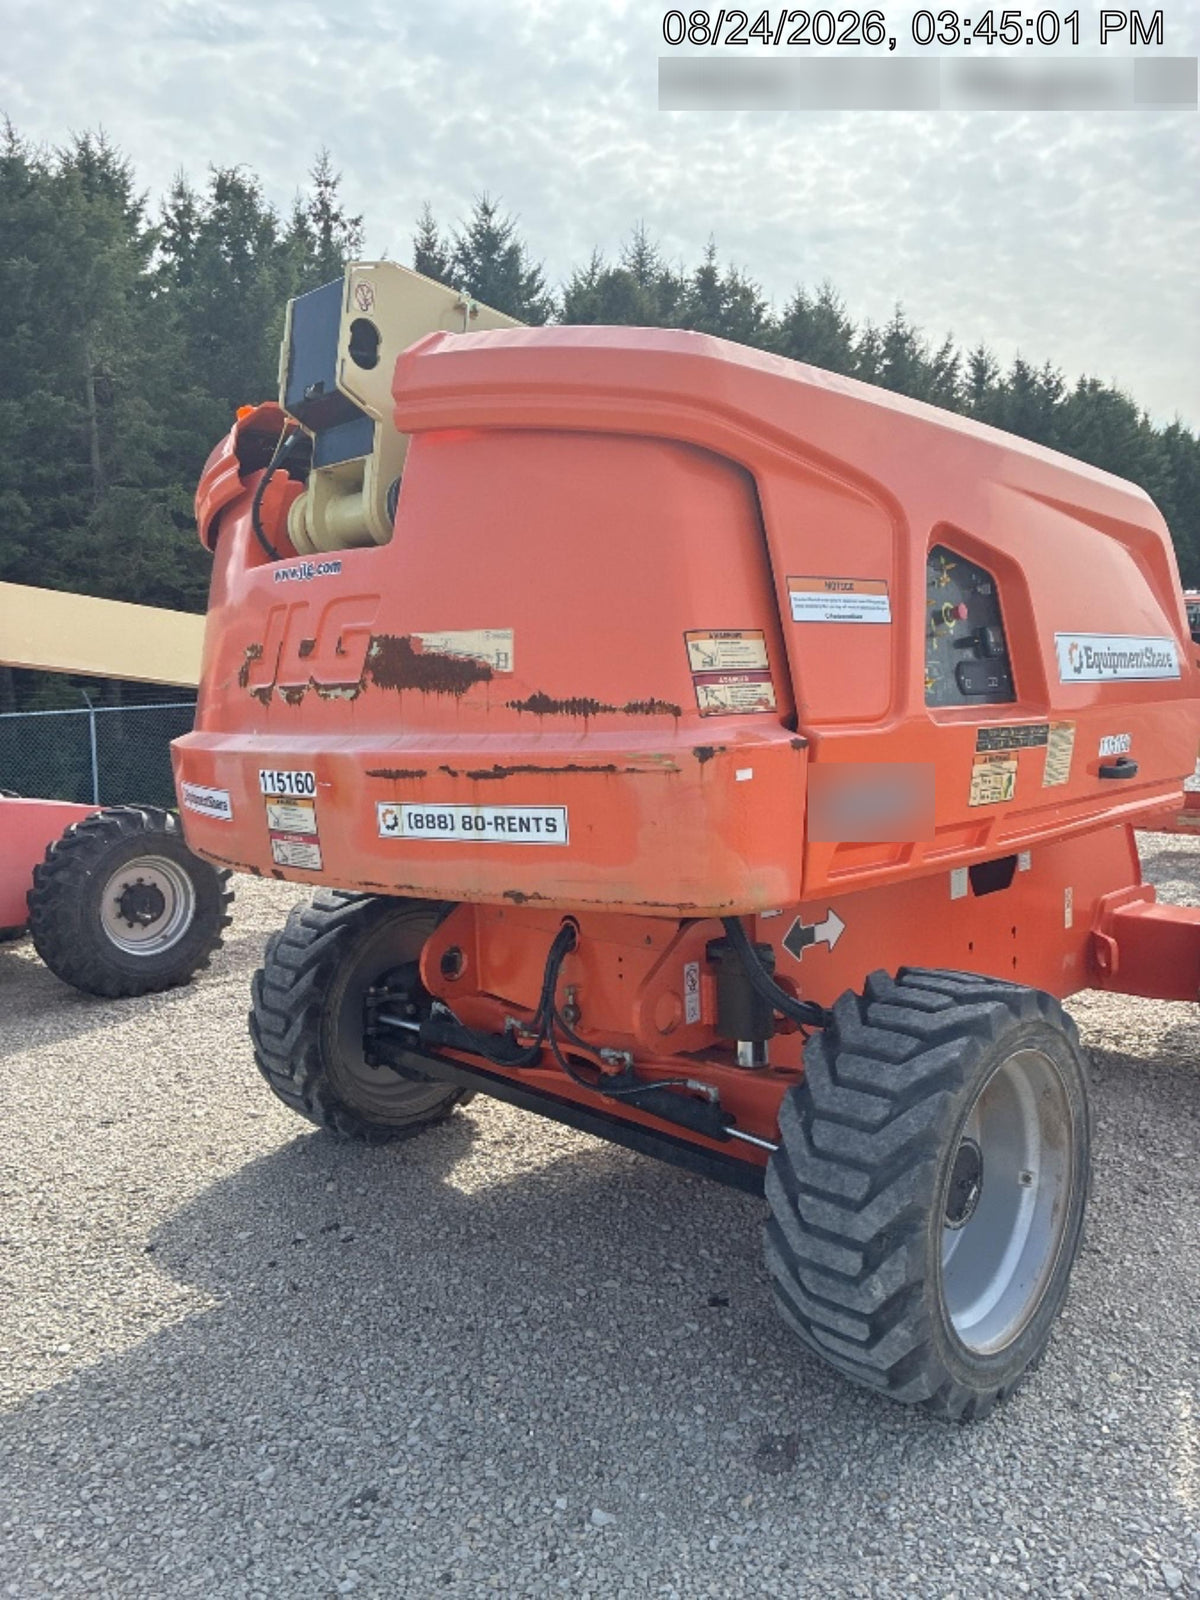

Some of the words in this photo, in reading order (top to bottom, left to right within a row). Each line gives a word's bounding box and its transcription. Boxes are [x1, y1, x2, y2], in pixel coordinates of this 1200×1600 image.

[274, 561, 342, 581] www.jlg.com
[247, 593, 381, 687] JLG
[1083, 646, 1173, 674] EquipmentShare
[260, 771, 315, 794] 115160
[408, 812, 455, 831] (888)
[461, 815, 558, 833] 80-RENTS
